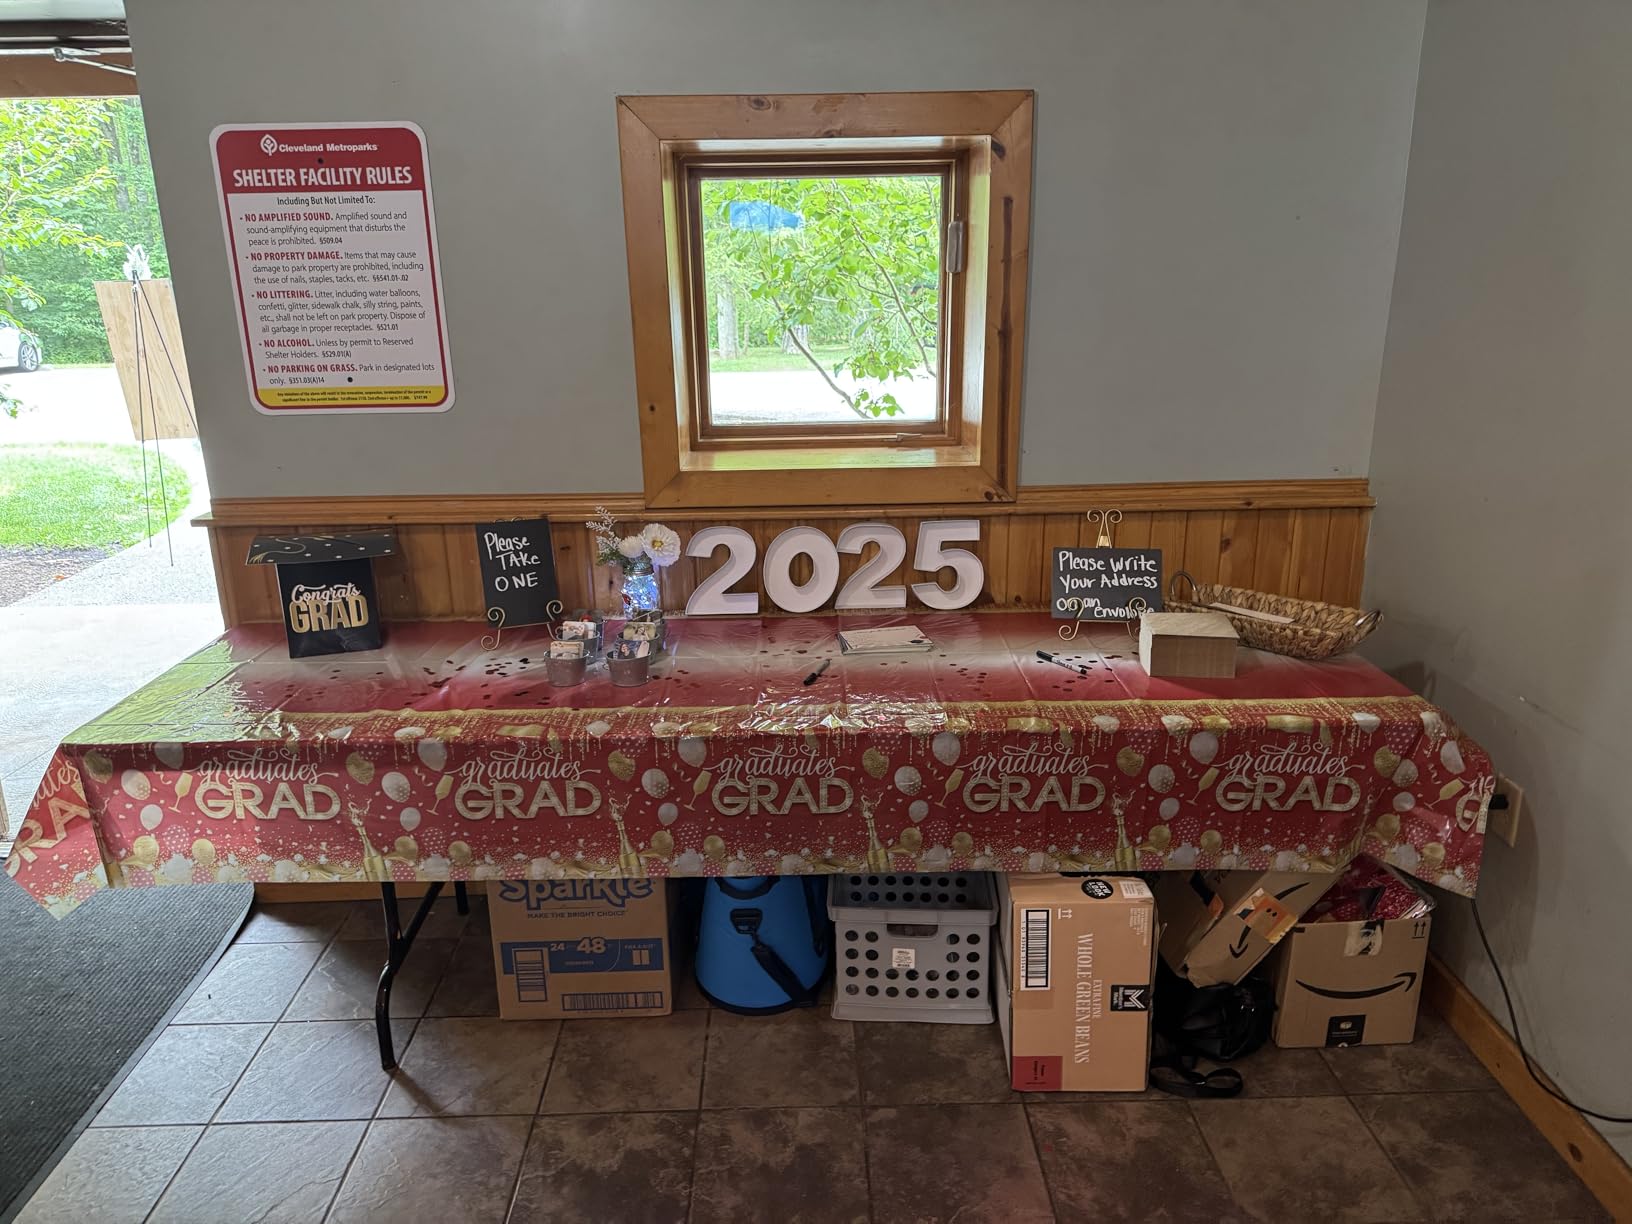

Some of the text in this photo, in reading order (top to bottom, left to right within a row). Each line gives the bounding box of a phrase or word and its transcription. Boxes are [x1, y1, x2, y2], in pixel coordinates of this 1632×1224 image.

[278, 142, 378, 153] Cleveland Metroparks
[233, 166, 412, 187] SHELTER FACILITY RULES
[276, 195, 376, 207] Including But Not Limited To:
[244, 211, 407, 222] NO AMPLIFIED SOUND. Amplified sound and
[309, 224, 348, 235] equipment
[348, 224, 363, 232] that
[364, 223, 393, 232] disturbs
[393, 223, 406, 231] the
[248, 239, 269, 247] peace
[270, 237, 277, 245] is
[277, 236, 316, 247] prohibited.
[250, 252, 263, 261] NO
[263, 251, 305, 261] PROPERTY
[307, 251, 343, 260] DAMAGE.
[364, 251, 379, 259] that
[380, 252, 395, 260] may
[252, 264, 281, 274] damage
[281, 265, 290, 273] to
[291, 263, 307, 274] park
[308, 264, 339, 273] property
[352, 262, 391, 273] prohibited,
[391, 261, 424, 272] including
[253, 275, 266, 284] the
[281, 275, 289, 284] of
[290, 275, 308, 284] nails,
[308, 274, 335, 285] staples,
[335, 274, 356, 283] tacks,
[356, 274, 370, 282] etc.
[256, 291, 268, 299] NO
[269, 290, 314, 299] LITTERING.
[314, 290, 334, 298] Litter,
[335, 290, 367, 299] including
[389, 288, 420, 297] balloons,
[258, 300, 423, 312] confetti, glitter, sidewalk chalk, silly string, paints,
[275, 313, 291, 322] shall
[305, 313, 315, 321] be
[316, 312, 329, 321] left
[340, 312, 356, 322] park
[357, 312, 389, 322] property.
[389, 311, 417, 321] Dispose
[418, 311, 426, 319] of
[261, 325, 270, 333] all
[271, 324, 300, 335] garbage
[300, 324, 308, 332] in
[309, 325, 332, 334] proper
[333, 323, 374, 333] receptacles.
[263, 339, 276, 348] NO
[277, 338, 315, 348] ALCOHOL.
[315, 338, 338, 347] Unless
[339, 338, 348, 348] by
[349, 338, 373, 347] permit
[382, 337, 414, 345] Reserved
[265, 350, 289, 359] Shelter
[290, 350, 319, 359] Holders.
[267, 365, 279, 374] NO
[280, 364, 316, 373] PARKING
[316, 364, 329, 373] ON
[330, 364, 358, 372] GRASS.
[383, 363, 421, 373] designated
[422, 363, 435, 371] lots
[269, 376, 286, 386] only.
[484, 532, 530, 560] Please
[685, 519, 985, 616] 2025
[1058, 551, 1158, 572] Please Write
[495, 572, 538, 592] ONE
[1100, 573, 1158, 588] Address
[291, 582, 361, 604] Congrats
[289, 595, 369, 633] GRAD
[183, 748, 339, 787] graduates
[445, 747, 600, 789] graduates
[703, 744, 855, 786] graduates
[956, 743, 1108, 783] graduates
[1211, 742, 1365, 783] graduates
[195, 782, 341, 819] GRAD
[455, 780, 601, 820] GRAD
[712, 778, 854, 816] GRAD
[963, 776, 1105, 812] GRAD
[1216, 775, 1360, 811] GRAD
[499, 878, 651, 910] Sparkle
[527, 911, 549, 919] MAKE
[550, 937, 606, 955] 24 48
[1074, 933, 1094, 1064] WHOLE GREEN BEANS
